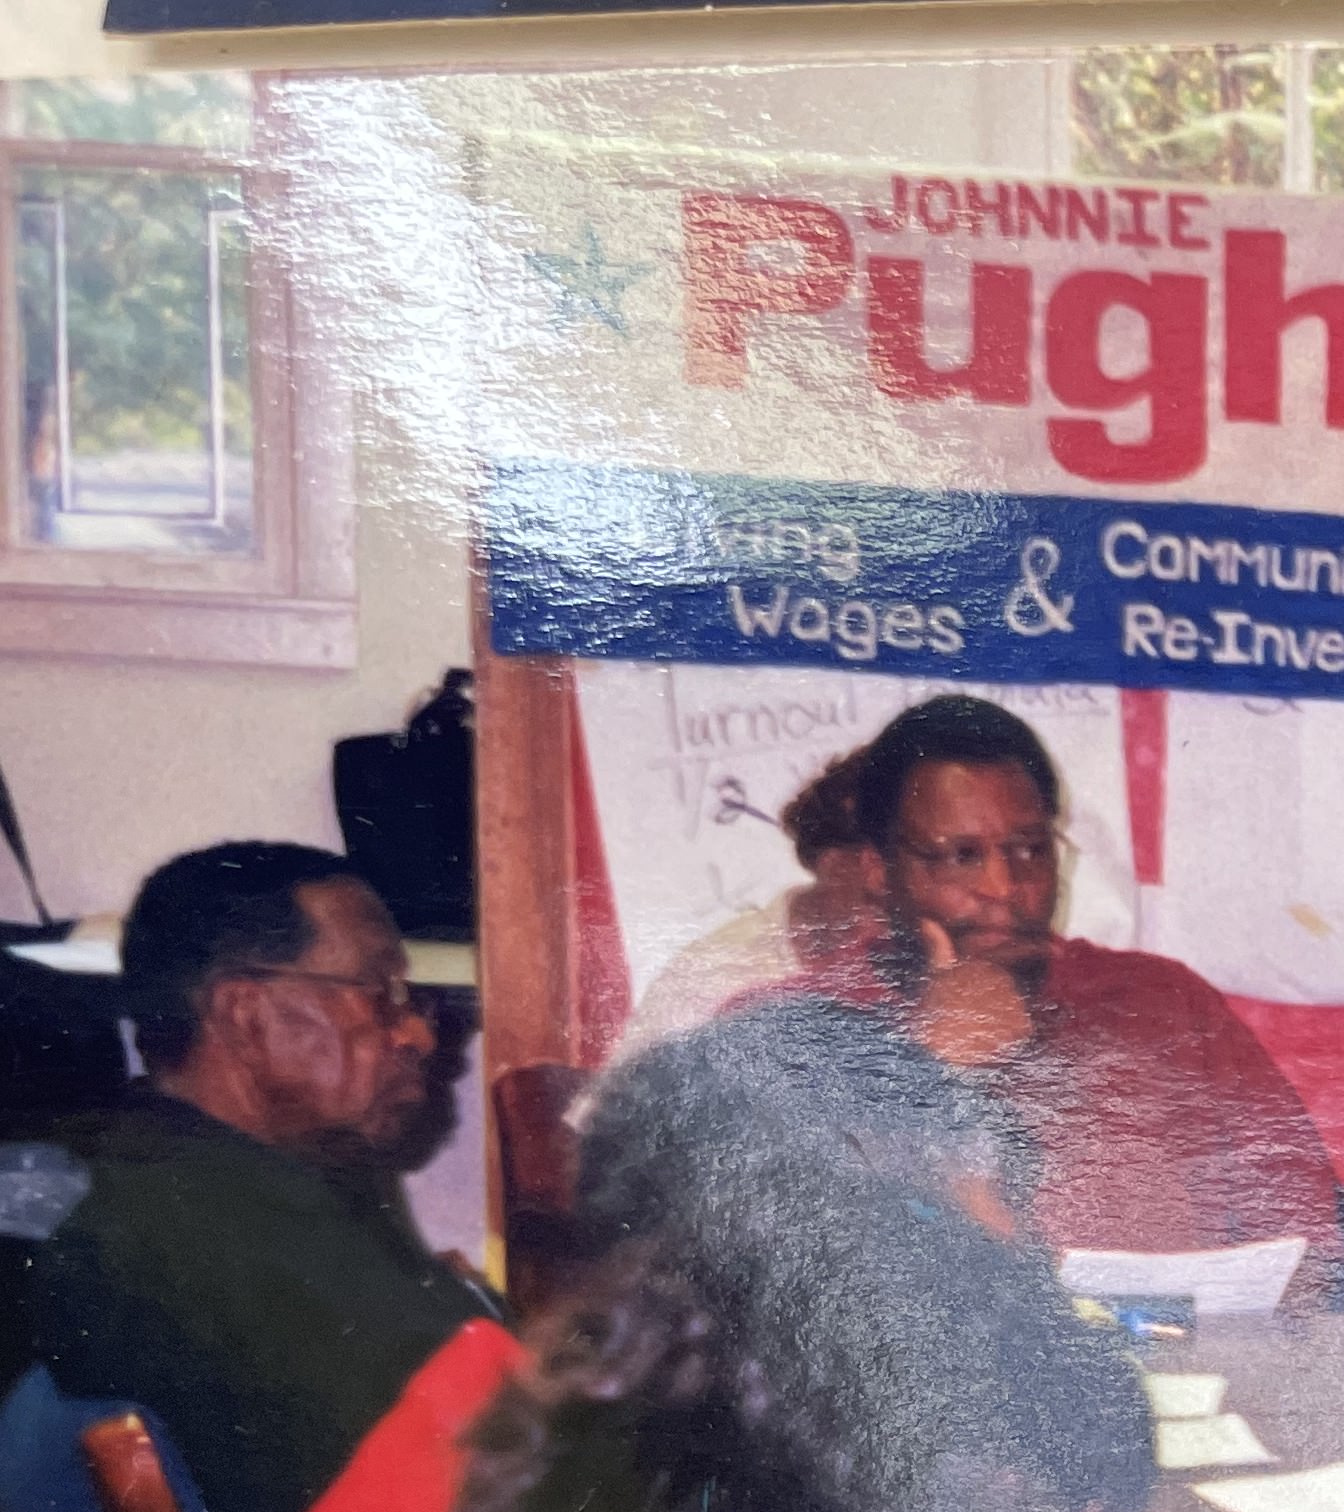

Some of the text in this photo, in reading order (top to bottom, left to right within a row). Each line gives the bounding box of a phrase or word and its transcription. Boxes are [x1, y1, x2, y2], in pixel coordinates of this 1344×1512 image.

[864, 174, 1214, 252] JOHNNIE
[726, 584, 965, 661] Wages
[1004, 536, 1075, 636] &
